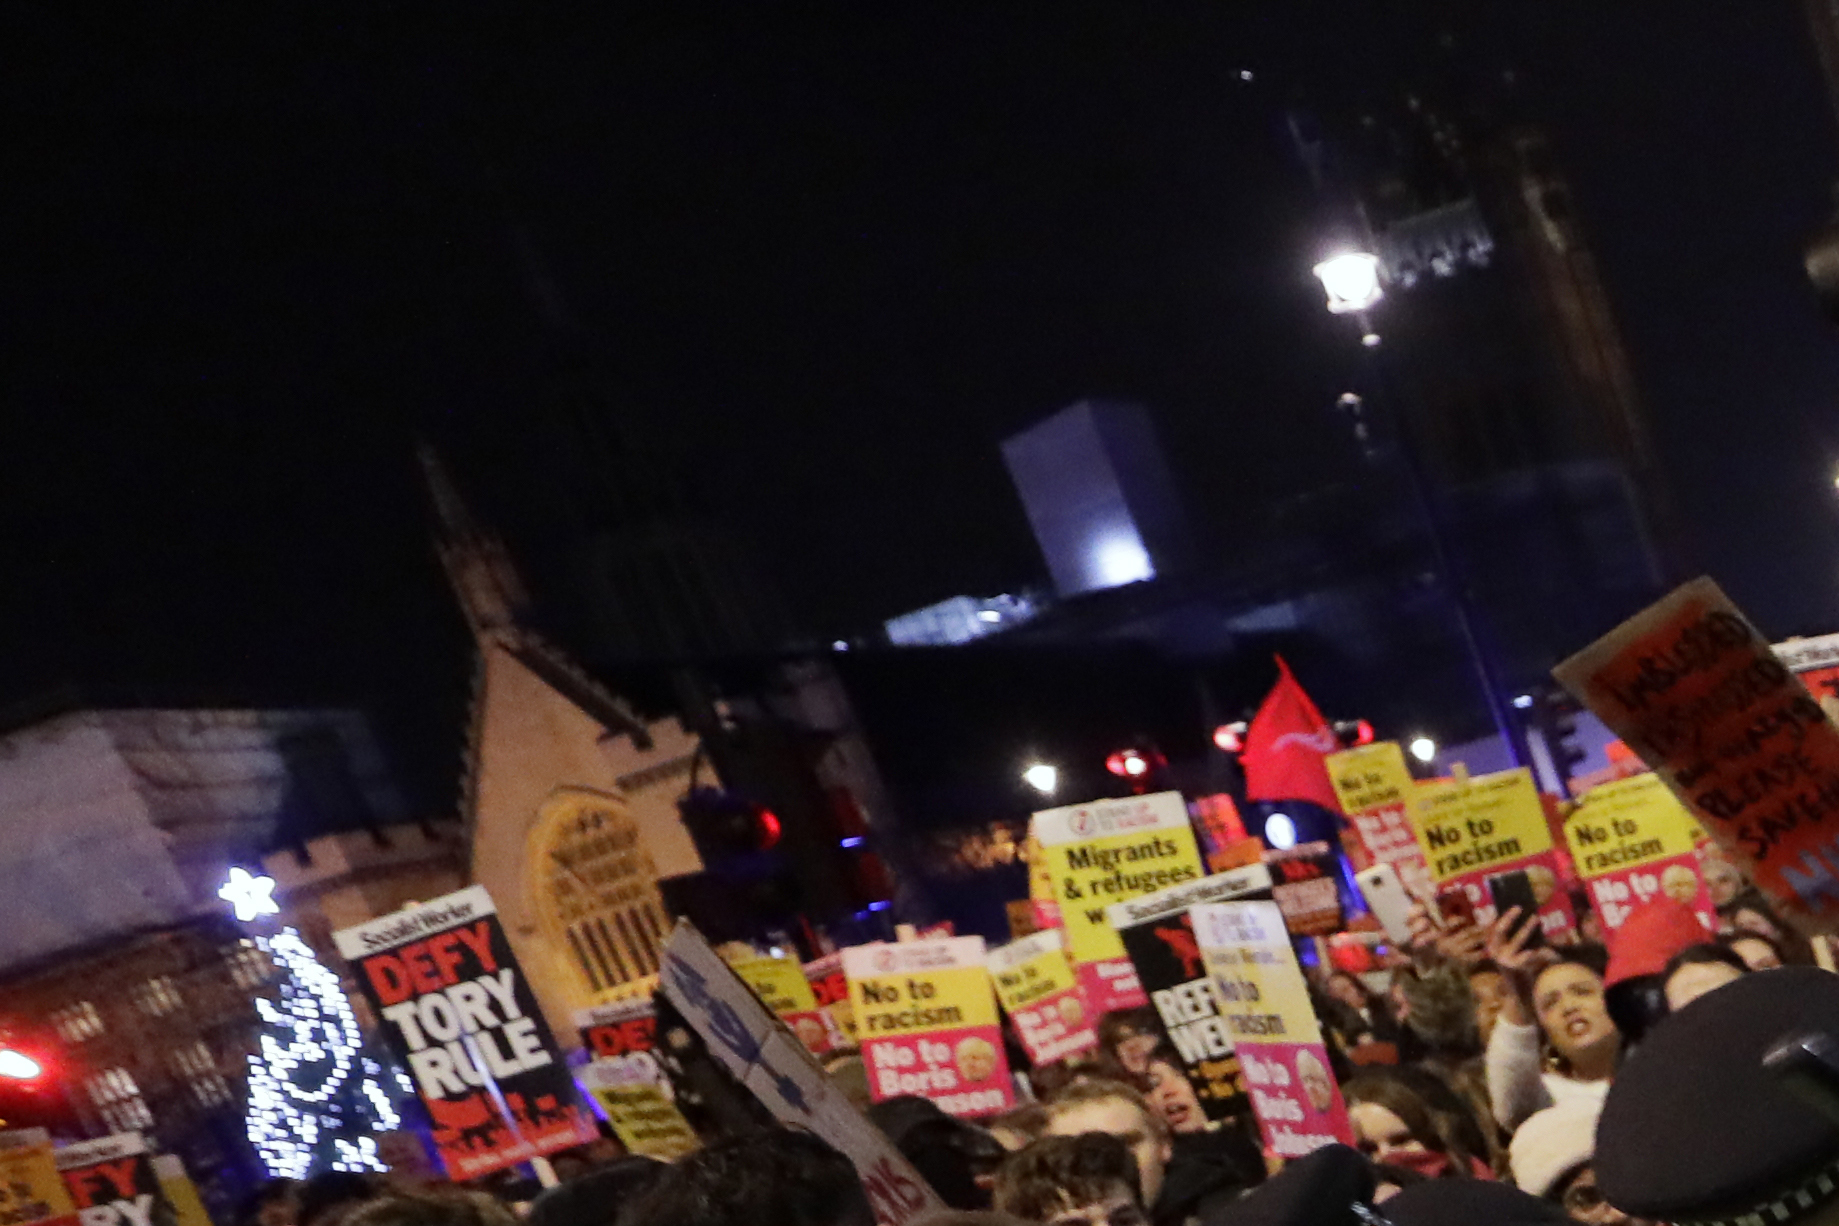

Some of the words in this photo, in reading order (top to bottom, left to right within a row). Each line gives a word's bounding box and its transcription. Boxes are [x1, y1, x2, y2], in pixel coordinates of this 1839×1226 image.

[1425, 825, 1462, 850] No
[1467, 817, 1495, 837] to
[1574, 823, 1608, 848] No
[1612, 817, 1639, 838] to
[1065, 836, 1179, 871] Migrants
[1436, 837, 1522, 875] racism
[1584, 838, 1664, 871] racism
[1063, 877, 1083, 900] &
[1089, 864, 1197, 894] refugees
[362, 920, 499, 1006] DEFY
[381, 967, 523, 1050] TORY
[861, 980, 899, 1005] No
[907, 978, 935, 999] to
[865, 1004, 963, 1032] racism
[588, 1016, 658, 1057] DE
[870, 1042, 916, 1069] No
[917, 1038, 951, 1064] to
[406, 1016, 553, 1099] RULE
[62, 1158, 138, 1209] FY
